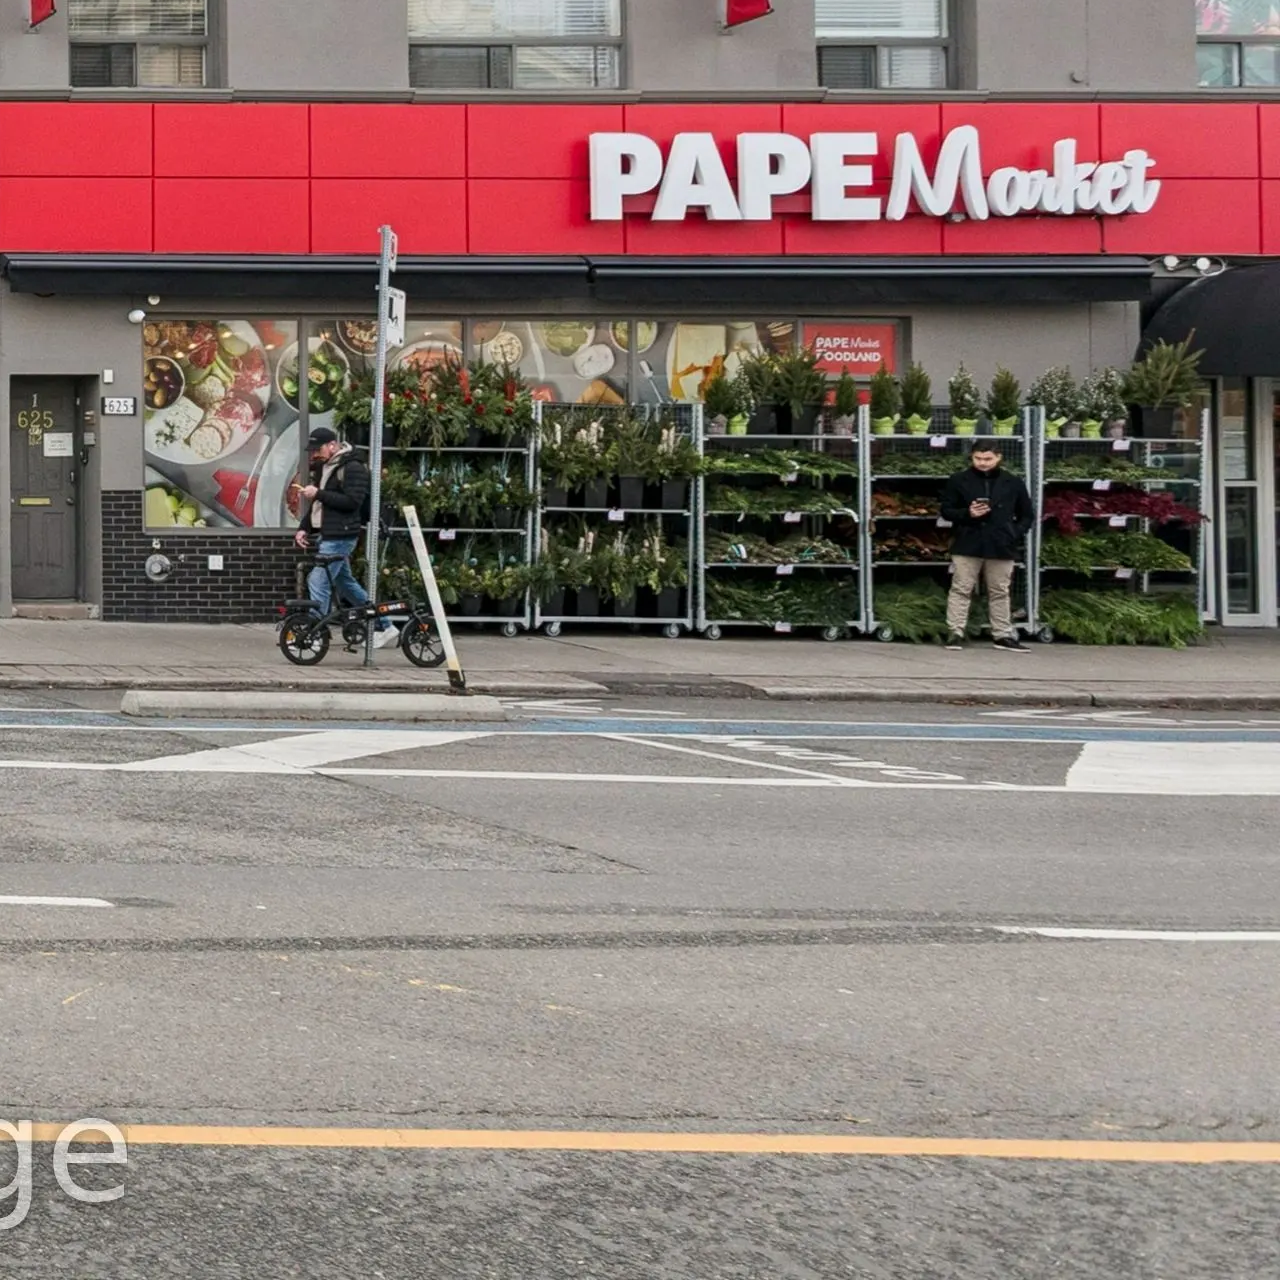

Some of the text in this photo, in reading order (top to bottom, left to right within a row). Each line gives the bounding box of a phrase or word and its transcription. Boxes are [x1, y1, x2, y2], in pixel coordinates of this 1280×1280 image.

[589, 124, 1161, 221] PAPE Market
[815, 336, 849, 348] PAPE
[815, 349, 882, 362] FOODLAND
[32, 393, 38, 408] 1
[108, 400, 129, 412] 625
[17, 410, 54, 429] 625
